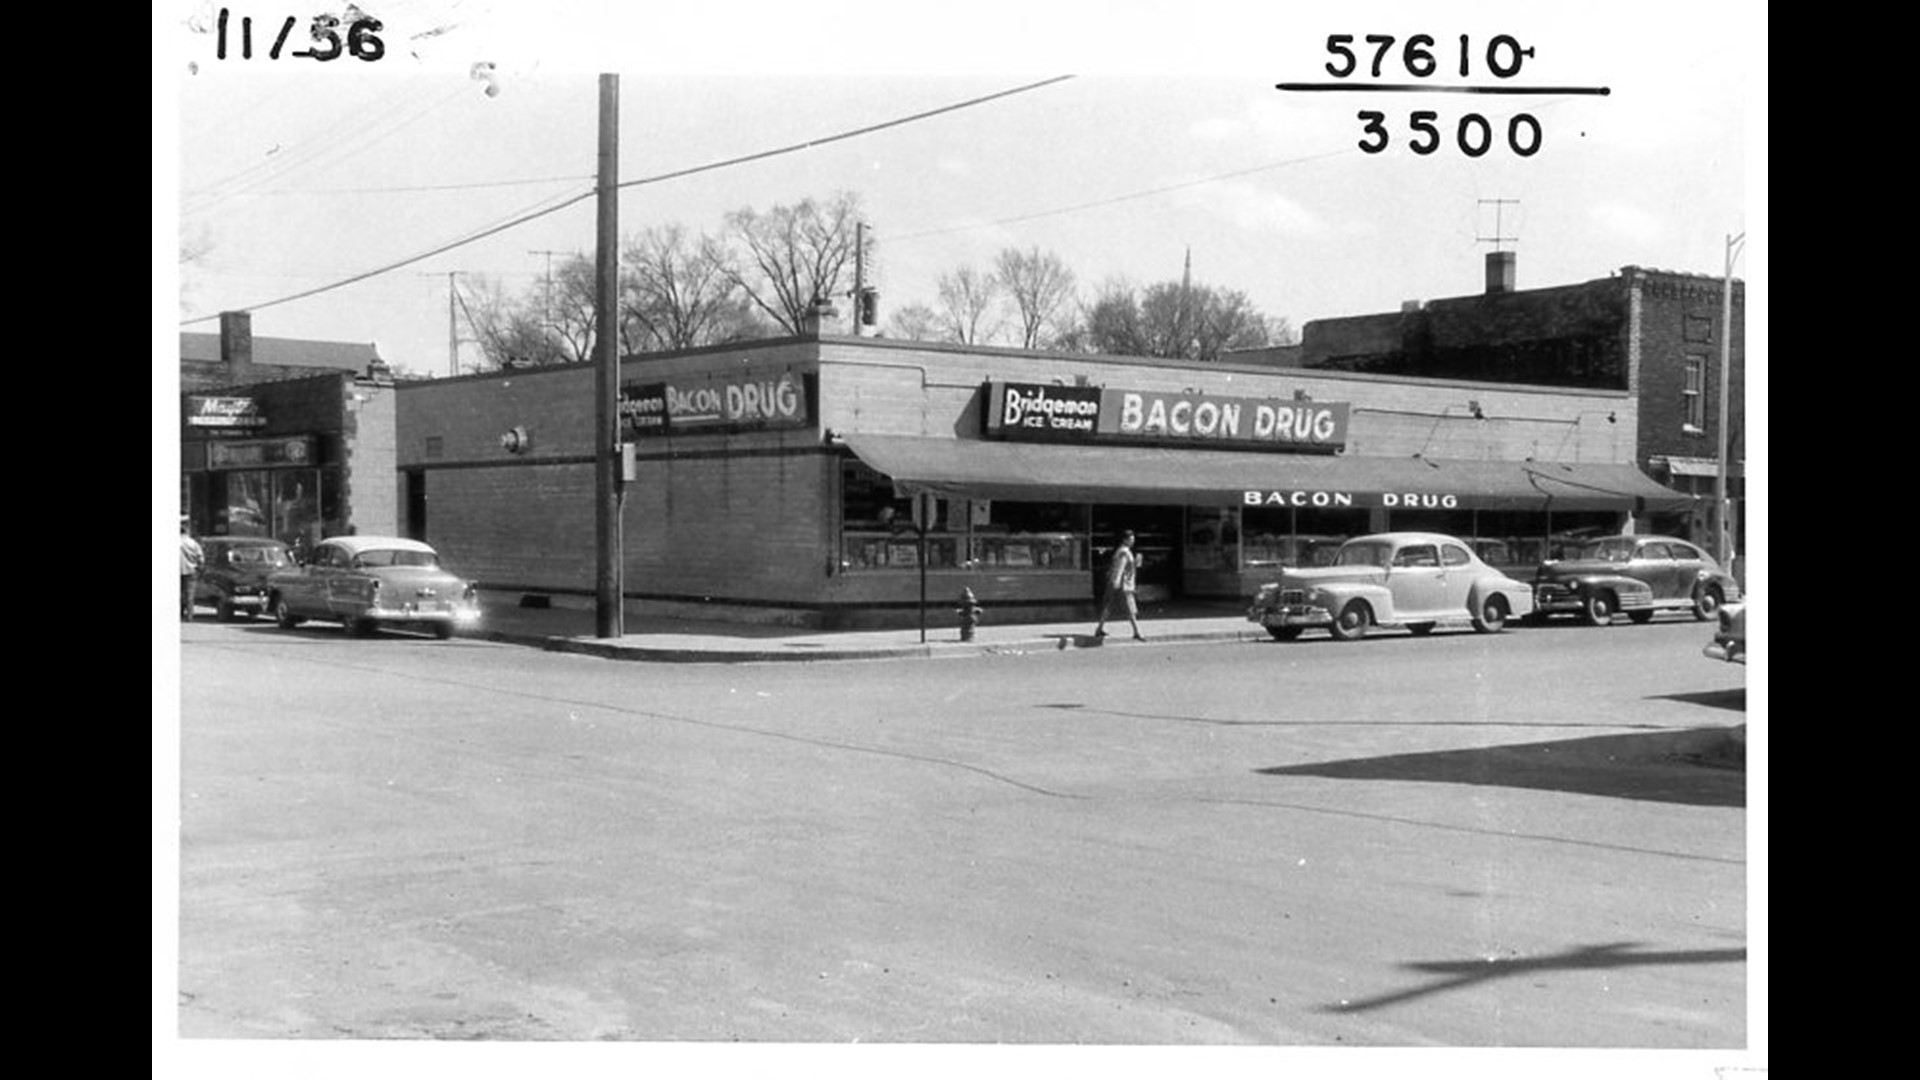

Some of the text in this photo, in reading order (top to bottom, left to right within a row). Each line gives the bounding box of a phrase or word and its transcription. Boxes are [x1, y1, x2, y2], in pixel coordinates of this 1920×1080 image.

[666, 381, 797, 420] BACON DRUG
[1004, 387, 1098, 425] Bridgeman
[1121, 392, 1336, 440] BACON DRUG
[1024, 415, 1093, 430] ICE CREAM
[1244, 491, 1458, 508] BACON DRUG
